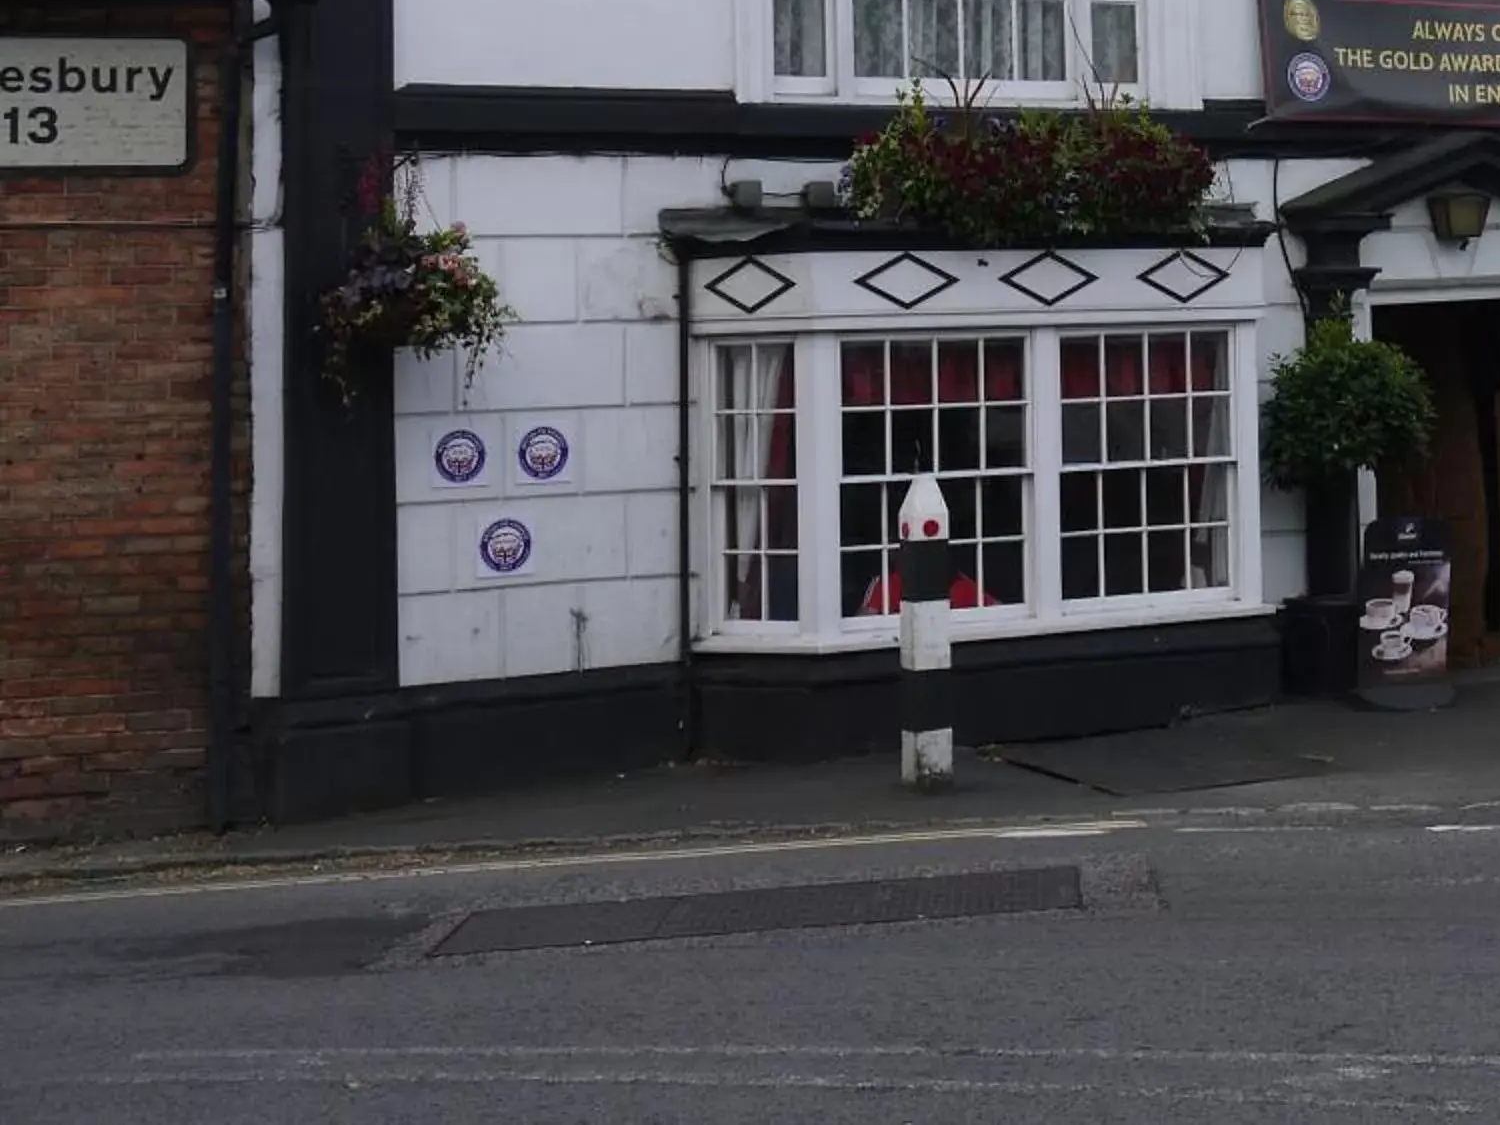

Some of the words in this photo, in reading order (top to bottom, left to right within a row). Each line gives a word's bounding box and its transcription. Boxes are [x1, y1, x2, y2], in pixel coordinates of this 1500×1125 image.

[1412, 19, 1485, 42] ALWAYS
[1333, 47, 1375, 68] THE
[1379, 50, 1434, 70] GOLD
[0, 57, 175, 100] esbury
[1448, 84, 1469, 103] IN
[3, 106, 59, 144] 13
